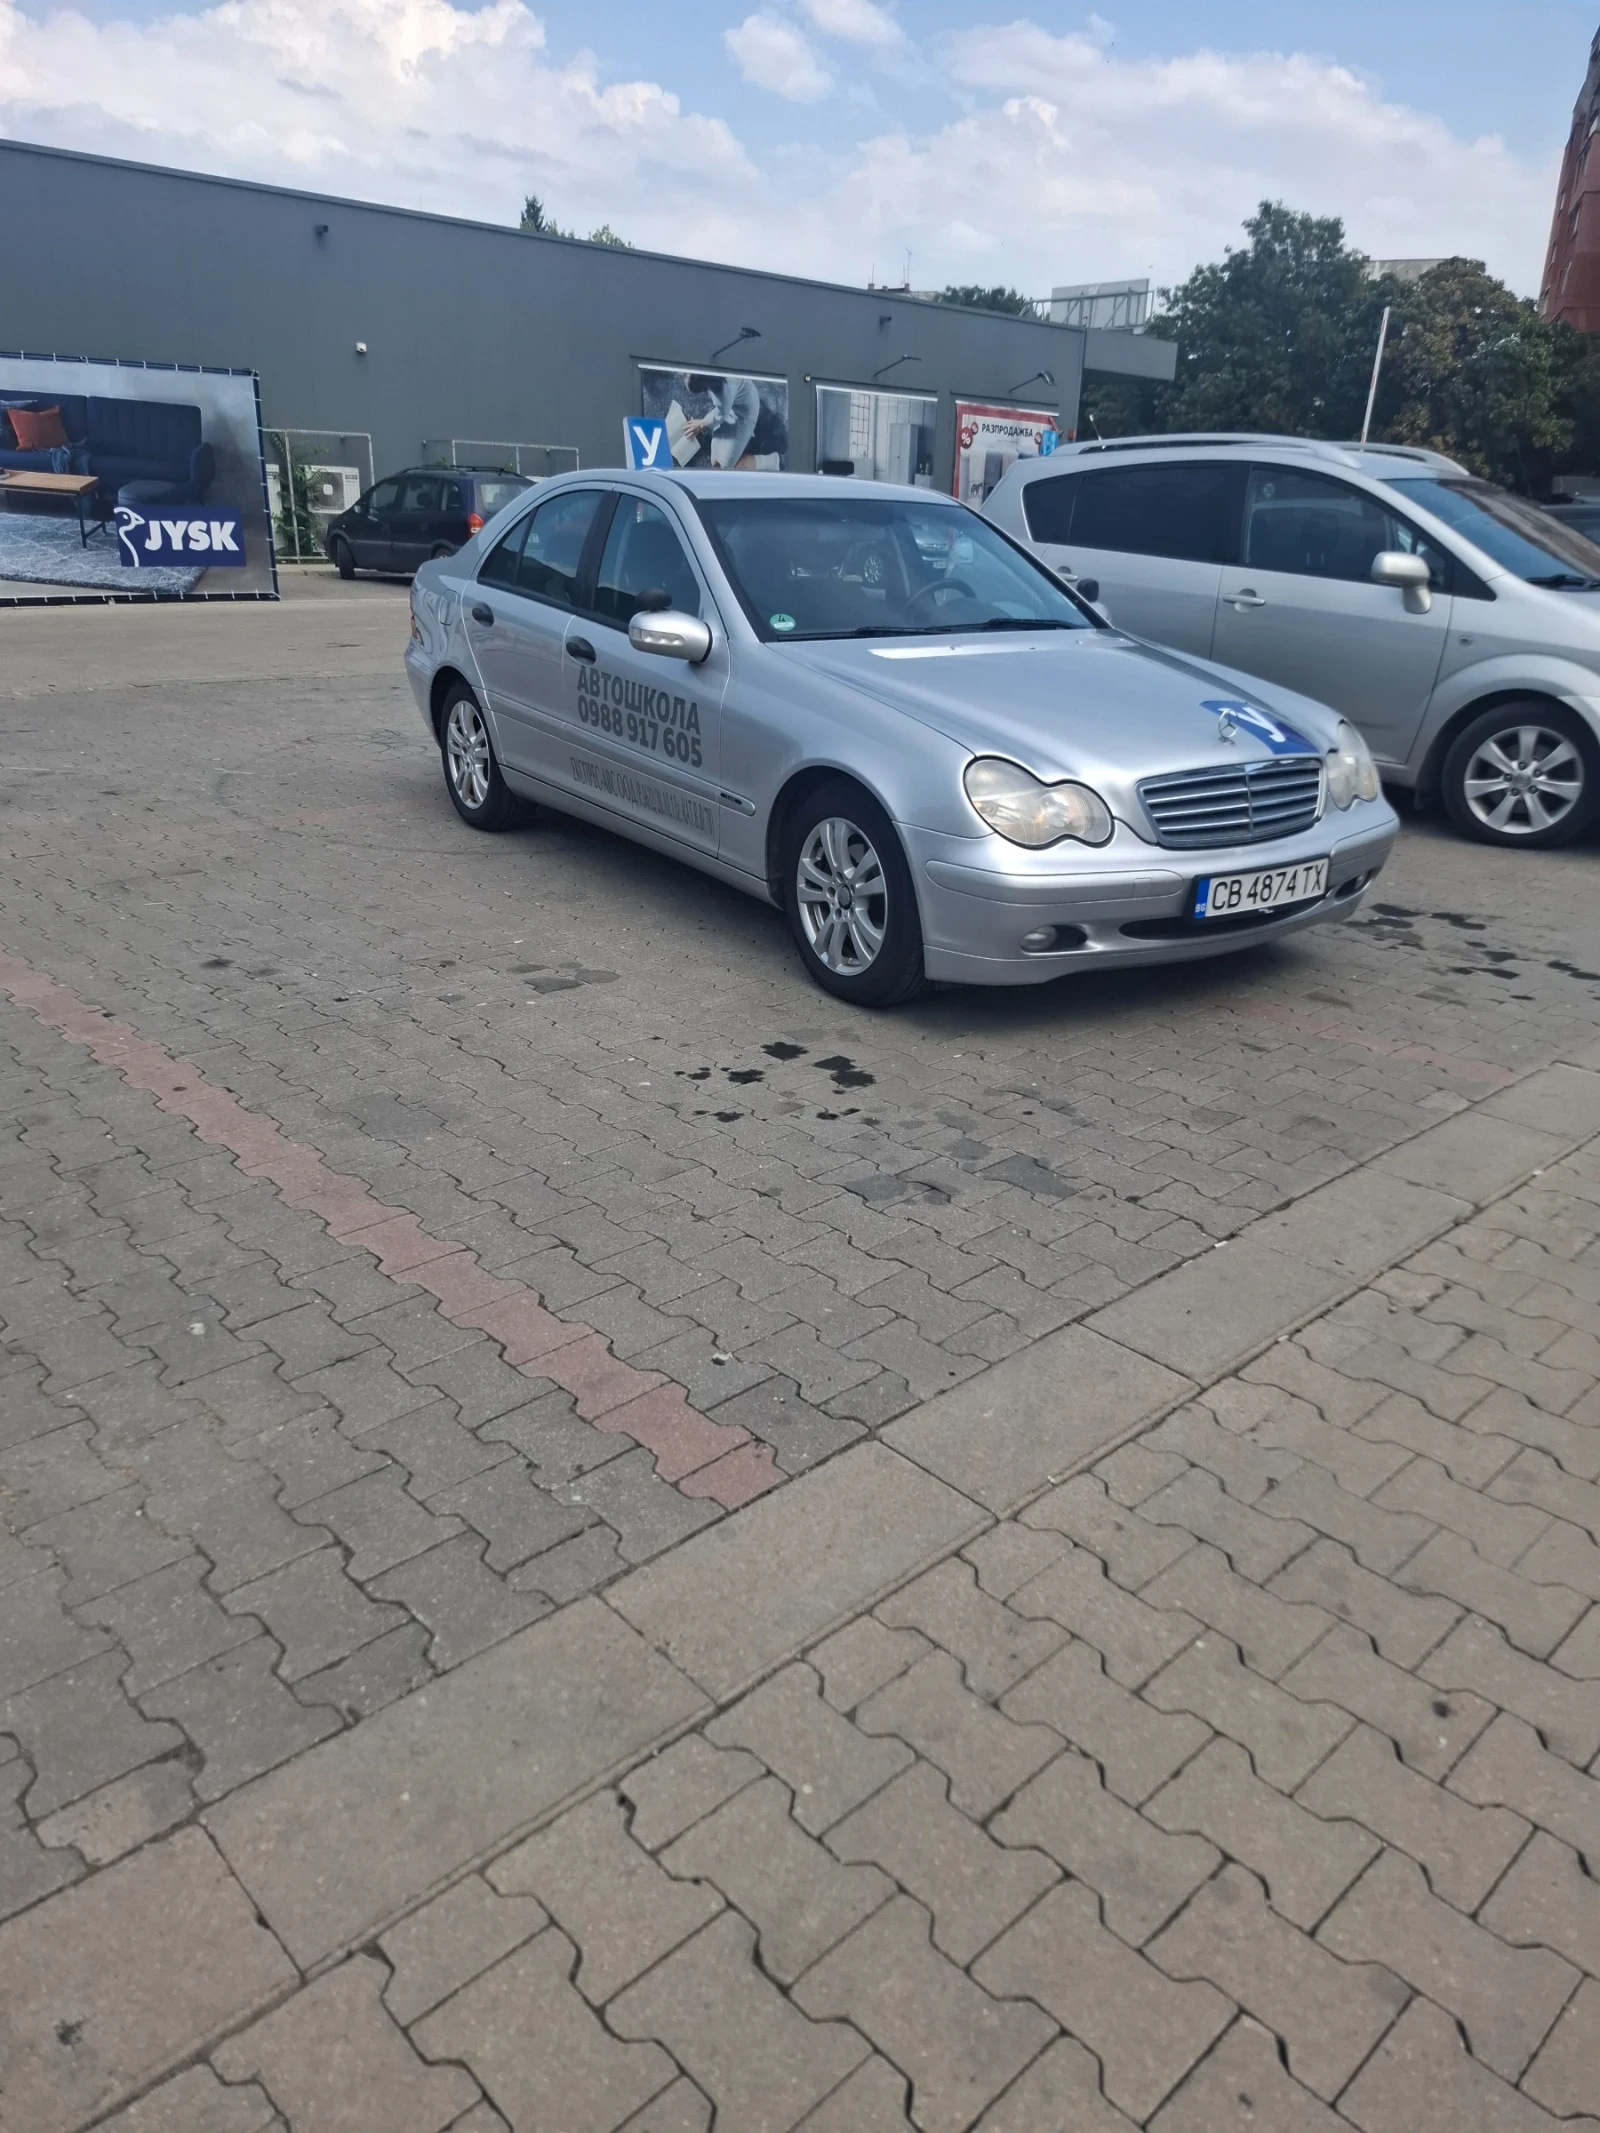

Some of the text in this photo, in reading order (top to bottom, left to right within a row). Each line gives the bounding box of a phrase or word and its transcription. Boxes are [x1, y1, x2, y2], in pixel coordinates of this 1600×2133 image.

[981, 423, 1033, 438] РАЗПРОДАЖБА
[144, 520, 240, 551] JYSK
[577, 665, 701, 735] АВТОШКОЛА
[578, 694, 703, 768] 0988 917 605
[1246, 869, 1298, 905] 4874
[1195, 903, 1206, 913] BG
